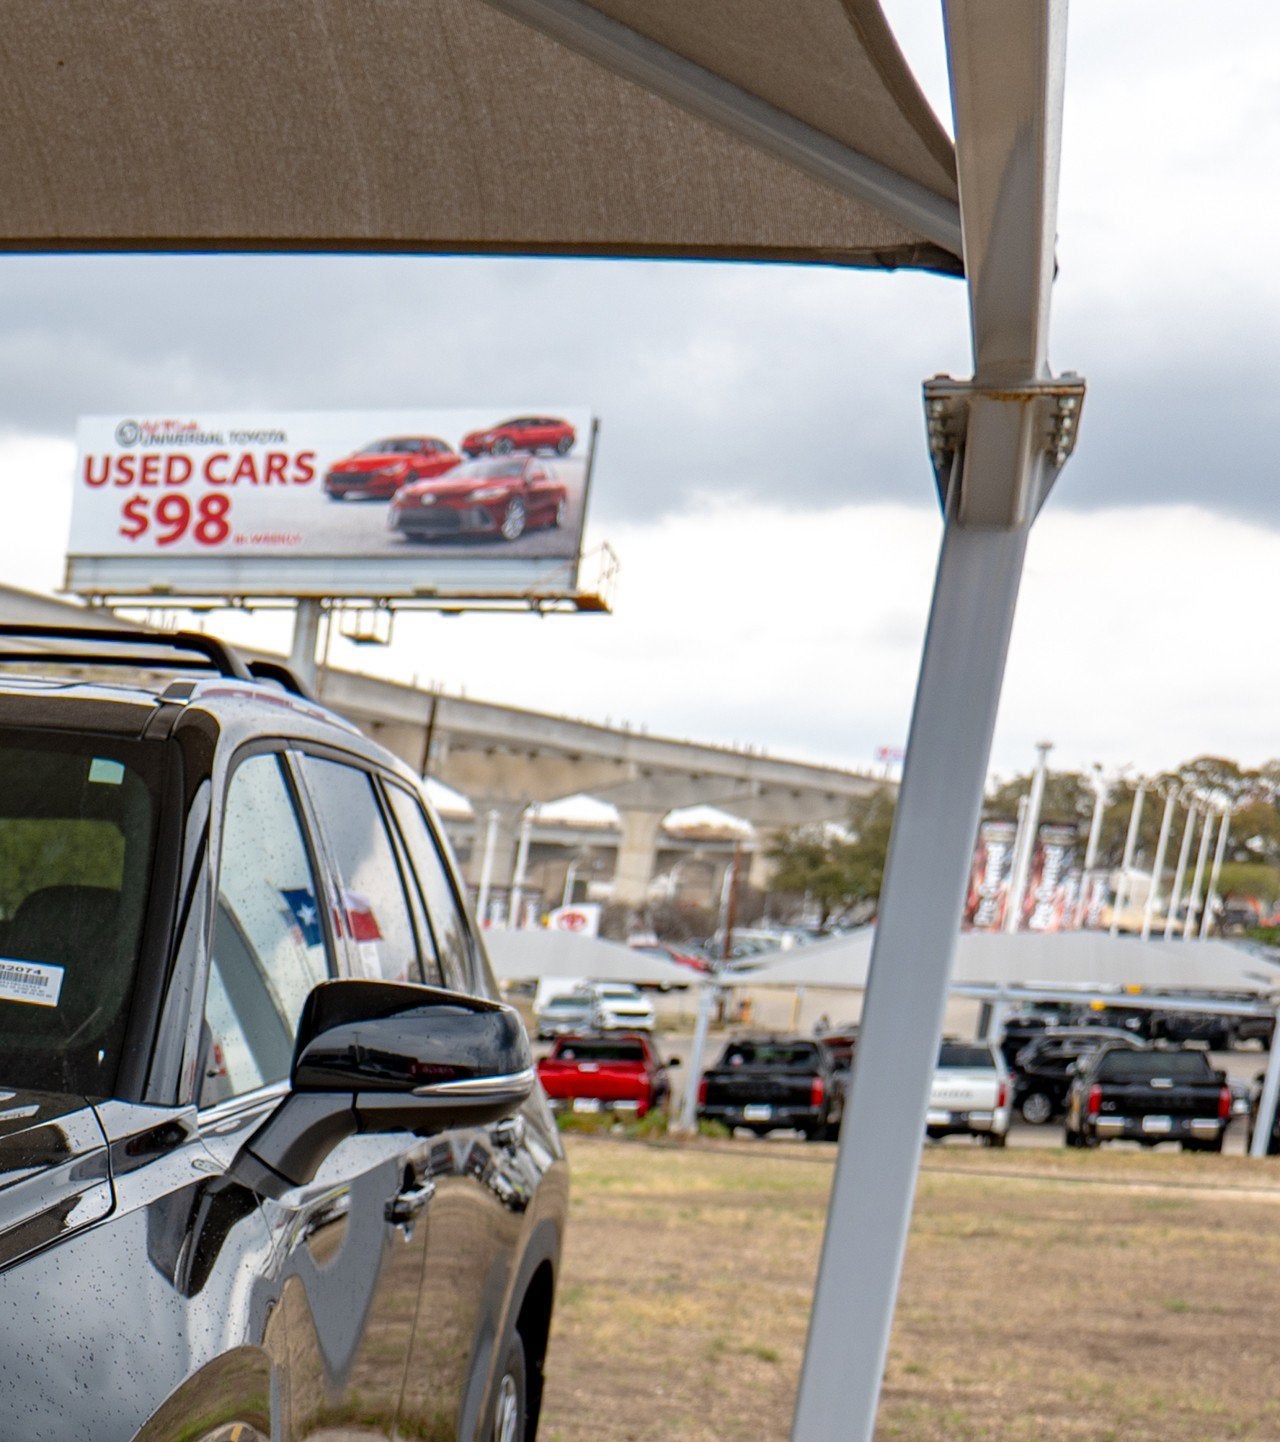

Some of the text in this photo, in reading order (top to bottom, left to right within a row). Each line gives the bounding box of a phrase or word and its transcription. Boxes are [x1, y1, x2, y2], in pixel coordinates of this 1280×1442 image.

[83, 450, 317, 488] USED CARS
[117, 492, 232, 547] $98
